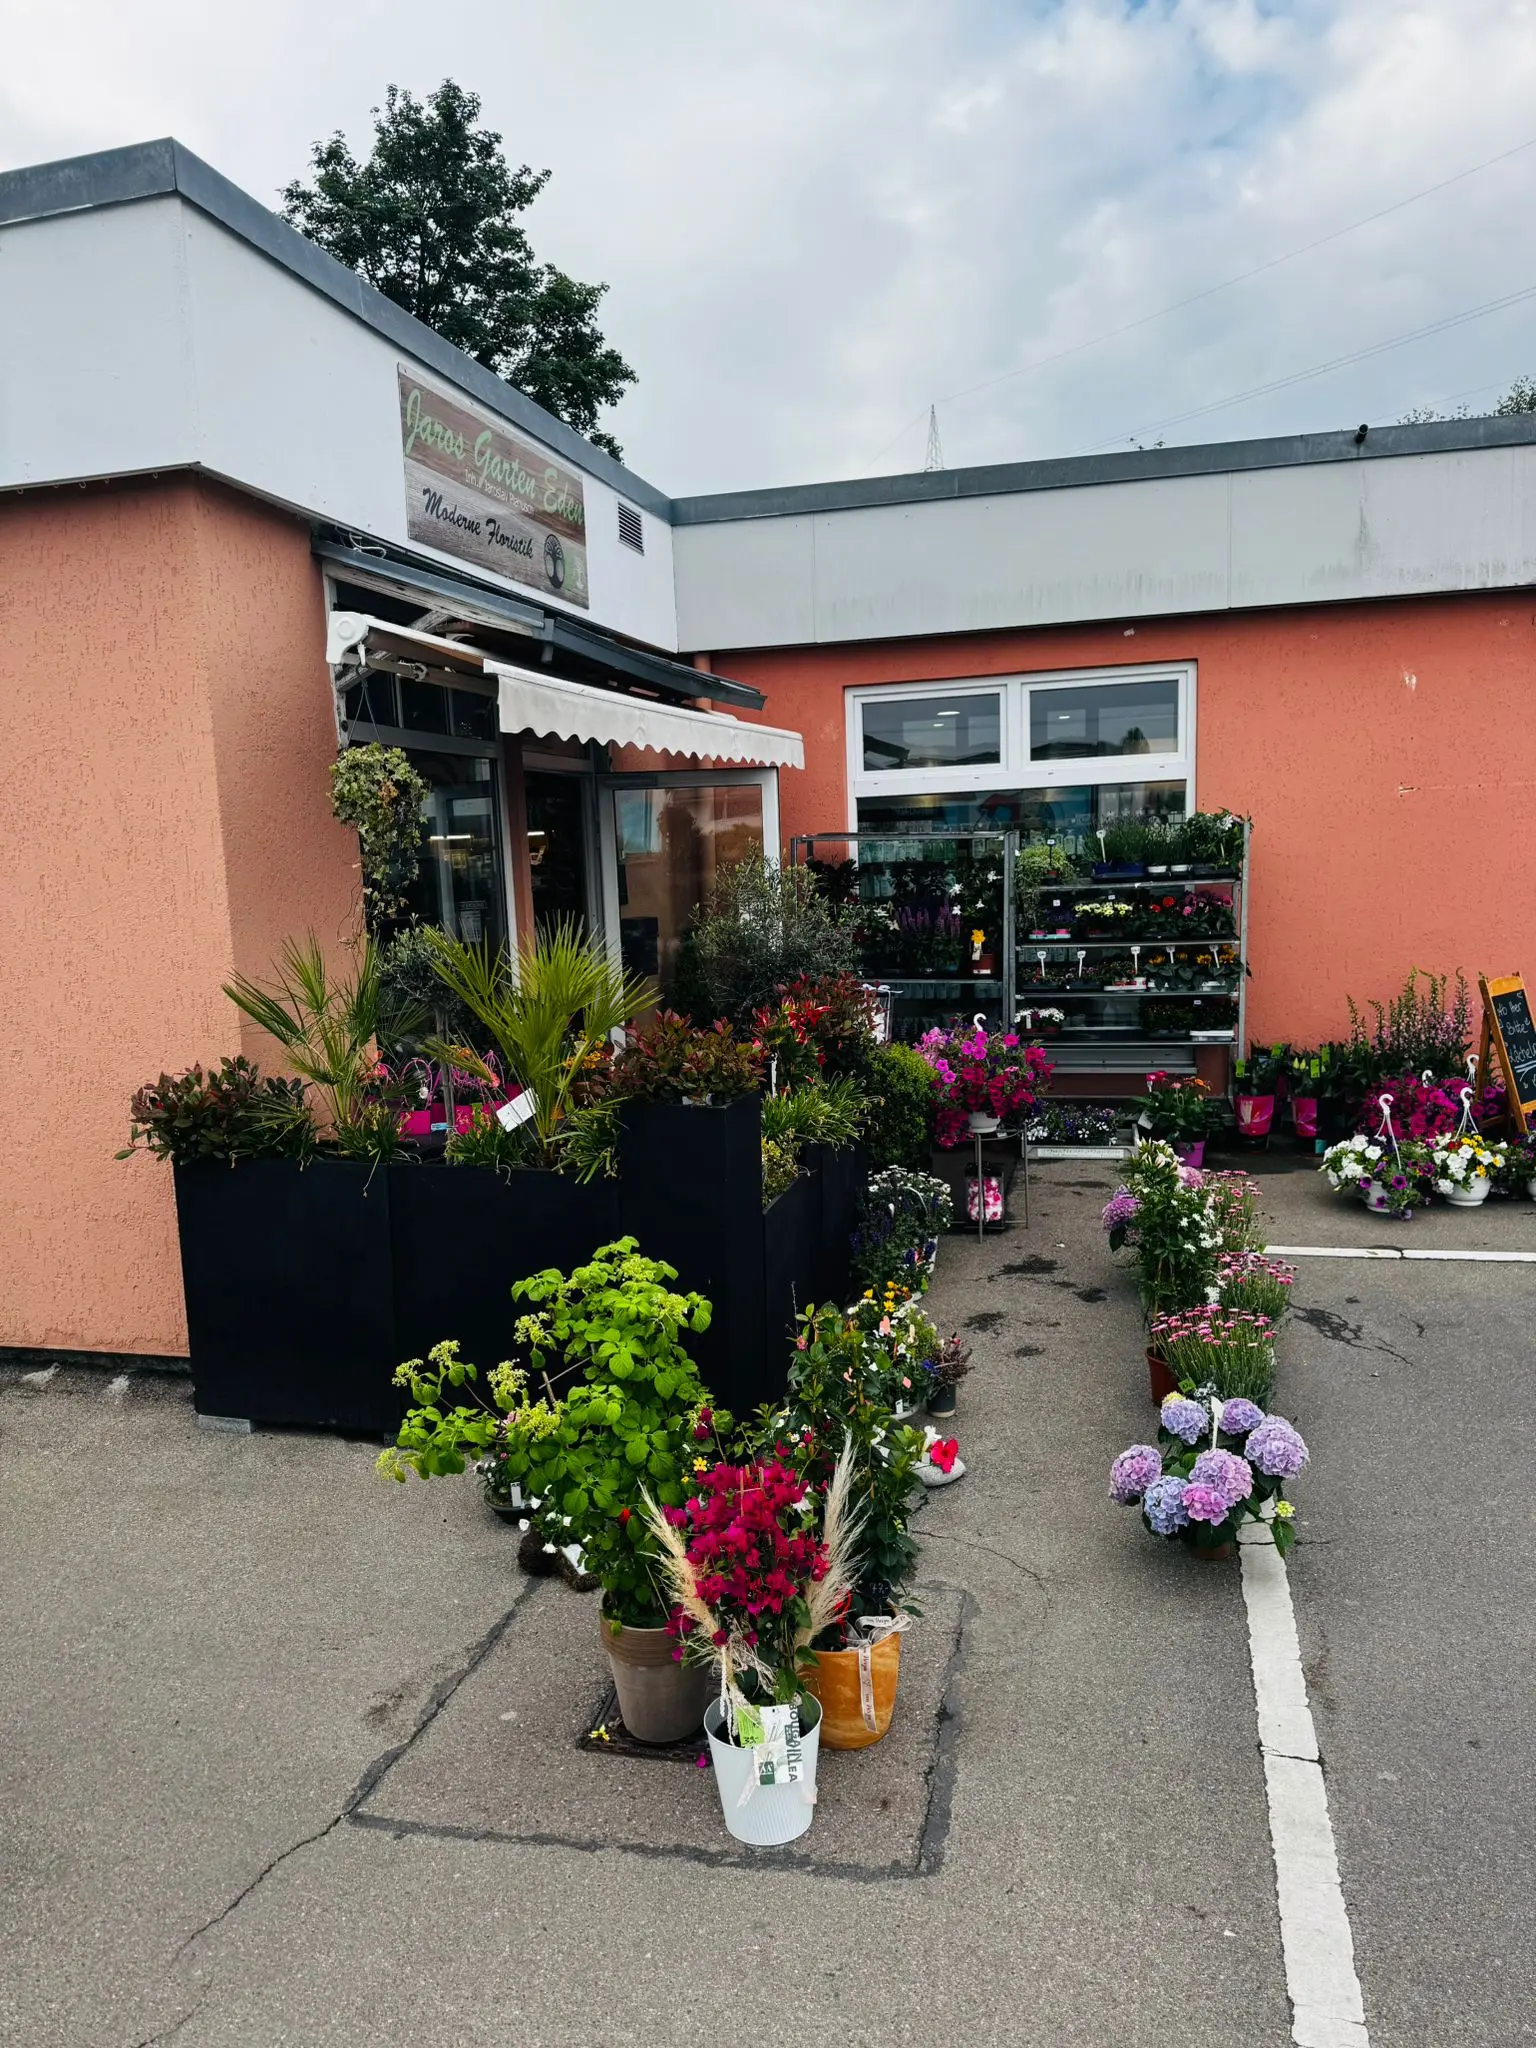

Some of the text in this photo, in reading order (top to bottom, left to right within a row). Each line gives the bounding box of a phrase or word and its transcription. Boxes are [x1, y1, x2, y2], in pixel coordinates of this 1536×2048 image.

[405, 388, 584, 524] Jaros Garten Eden
[422, 487, 534, 559] Moderne Floristik
